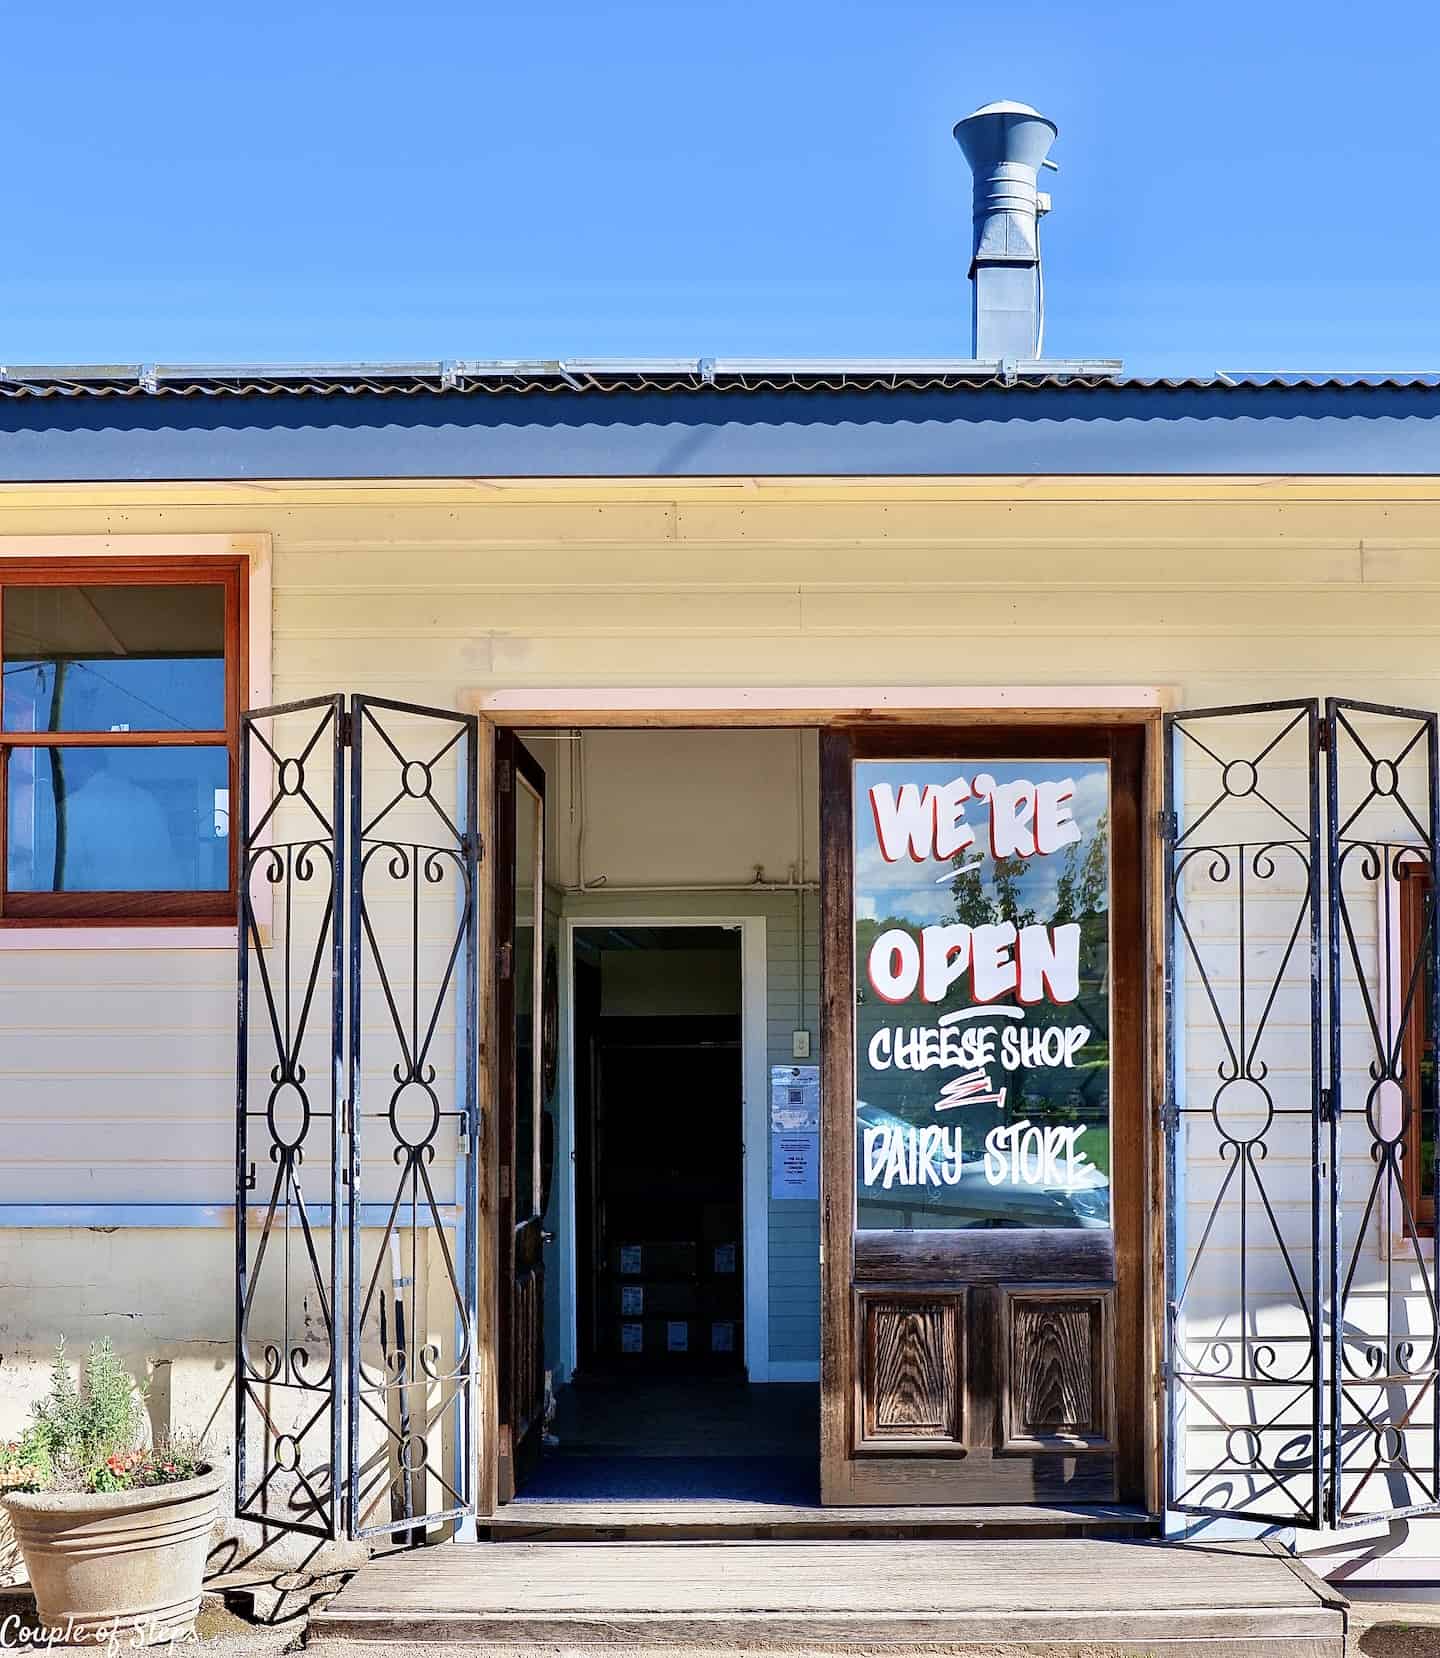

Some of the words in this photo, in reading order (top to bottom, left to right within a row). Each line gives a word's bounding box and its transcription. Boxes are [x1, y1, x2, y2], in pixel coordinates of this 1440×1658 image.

[869, 774, 1082, 863] WE'RE
[868, 920, 1081, 1006] OPEN
[868, 1025, 998, 1071] CHEESE
[1001, 1025, 1091, 1071] SHOP
[863, 1124, 962, 1189] DAIRY
[984, 1119, 1096, 1186] STORE
